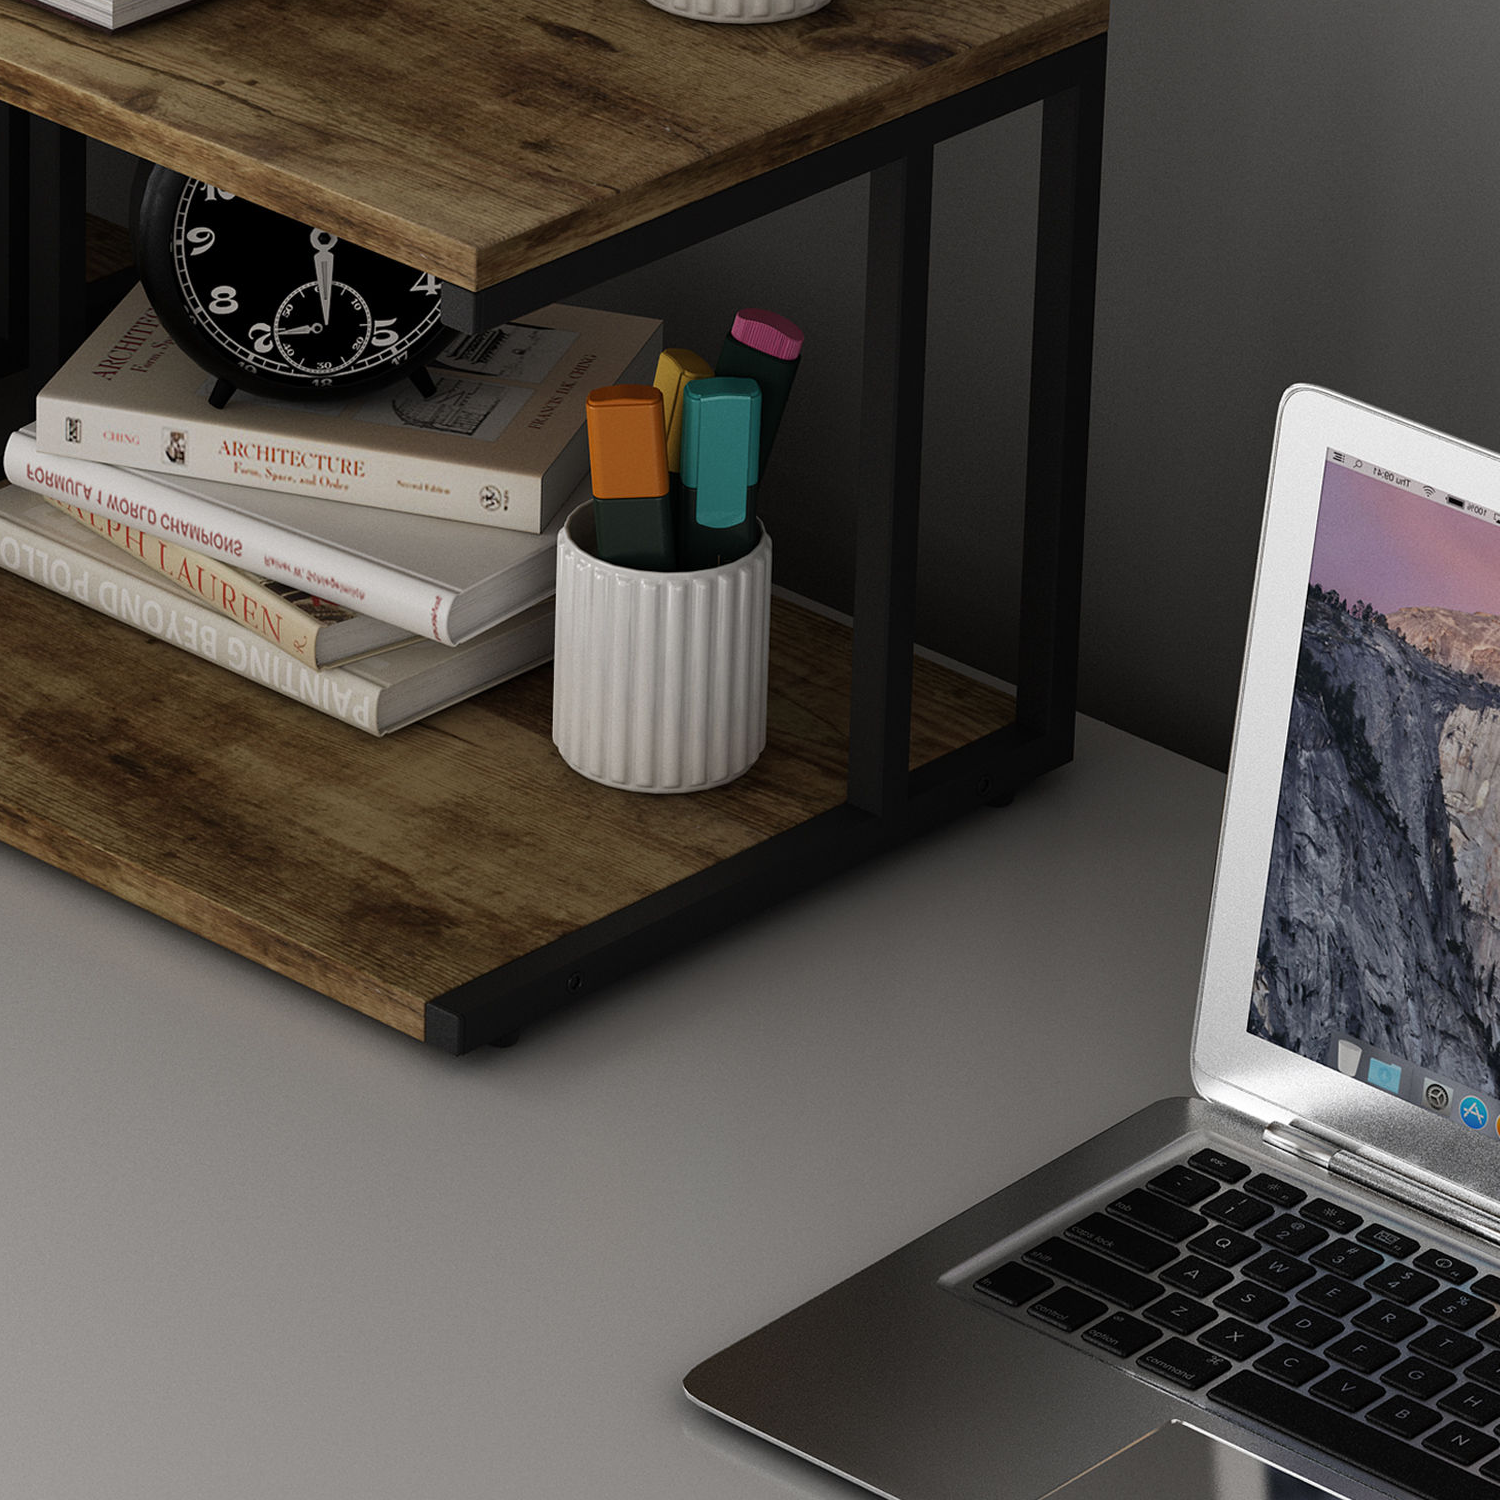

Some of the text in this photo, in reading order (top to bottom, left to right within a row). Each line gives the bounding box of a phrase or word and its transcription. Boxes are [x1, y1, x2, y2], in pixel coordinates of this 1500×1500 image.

[186, 226, 216, 257] 9
[409, 271, 443, 296] 4
[208, 285, 239, 315] 8
[350, 298, 363, 312] 10
[281, 303, 295, 319] 50
[247, 321, 275, 354] 7
[370, 317, 400, 348] 5
[281, 342, 296, 358] 40
[351, 335, 366, 352] 20
[130, 351, 164, 374] Form,
[316, 360, 333, 371] 30
[390, 351, 409, 367] 17
[311, 377, 333, 388] 18
[528, 353, 598, 430] FRANCIS CHING
[102, 429, 141, 446] CHING
[218, 440, 367, 479] ARCHITECTURE
[233, 461, 350, 492] Form, Space, and Order
[157, 539, 284, 644] LAUREN
[99, 580, 218, 661] BEYOND
[226, 635, 371, 730] PAINTING
[1209, 1156, 1228, 1168] esc
[1115, 1200, 1133, 1213] tab
[1070, 1224, 1115, 1249] caps lock
[1215, 1238, 1232, 1249] Q
[1030, 1249, 1054, 1263] shift
[1183, 1268, 1201, 1280] A
[1268, 1260, 1290, 1274] W
[1240, 1293, 1256, 1304] S
[1325, 1286, 1342, 1298] E
[1034, 1302, 1070, 1322] control
[1170, 1304, 1189, 1317] Z
[1380, 1312, 1397, 1324] R
[1088, 1326, 1120, 1348] option
[1224, 1331, 1245, 1343] X
[1146, 1354, 1197, 1382] command
[1282, 1357, 1299, 1369] C
